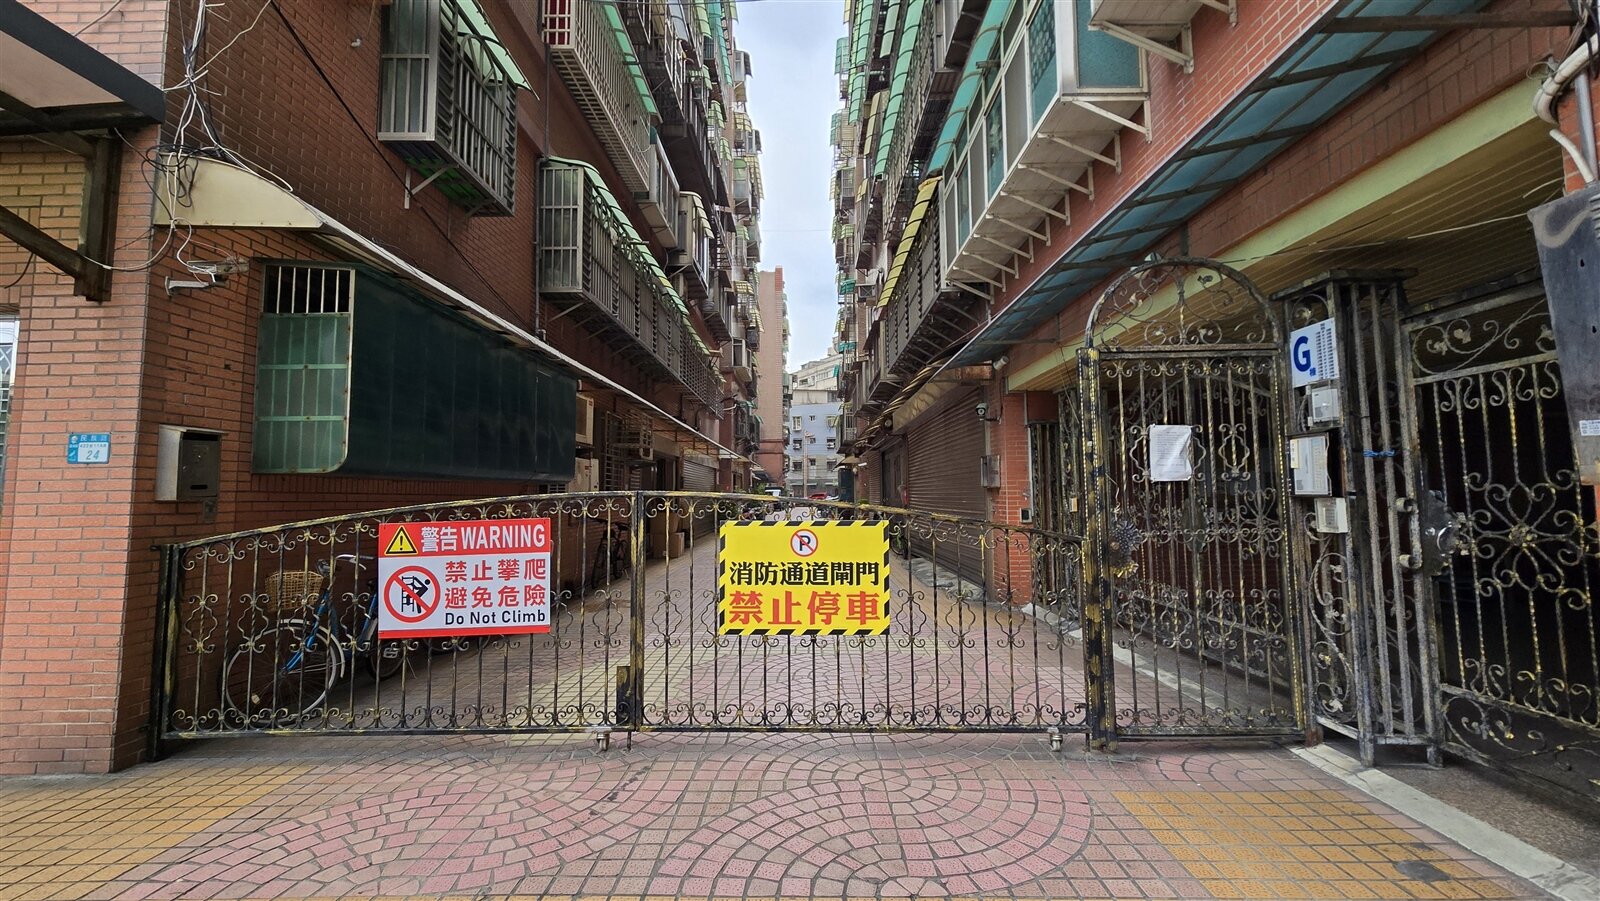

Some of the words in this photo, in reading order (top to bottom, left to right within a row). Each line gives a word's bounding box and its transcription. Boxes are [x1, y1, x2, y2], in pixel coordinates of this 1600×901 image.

[86, 450, 100, 460] 24
[421, 526, 457, 552] 警告
[460, 524, 545, 550] WARNING
[445, 558, 546, 583] 禁止攀爬
[729, 561, 880, 586] 消防通道閘門
[444, 584, 546, 609] 避免危險
[728, 590, 881, 625] 禁止停車
[445, 612, 464, 625] Do
[470, 611, 496, 624] Not
[501, 609, 546, 623] Climb
